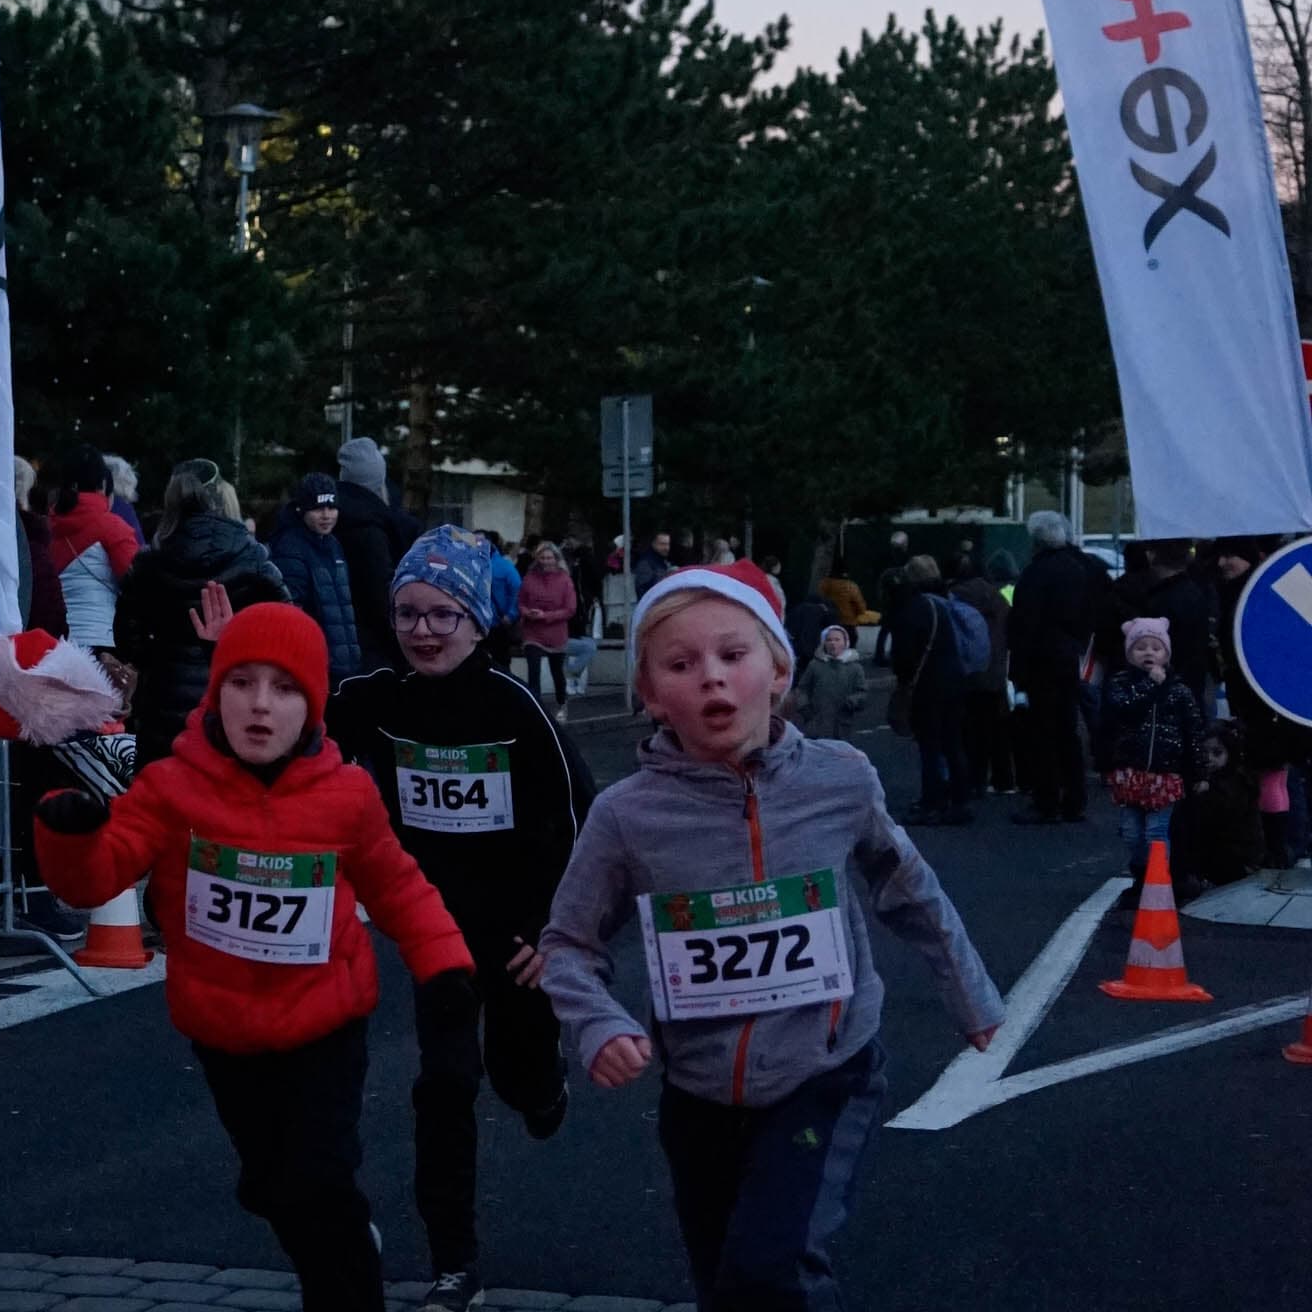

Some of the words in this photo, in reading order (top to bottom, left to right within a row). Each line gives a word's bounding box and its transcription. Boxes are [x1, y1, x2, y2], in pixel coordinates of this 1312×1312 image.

[317, 493, 336, 503] UFC
[440, 749, 468, 761] KIDS
[410, 774, 489, 810] 3164
[258, 856, 294, 870] KIDS
[736, 884, 778, 904] KIDS
[207, 883, 308, 935] 3127
[685, 924, 815, 984] 3272
